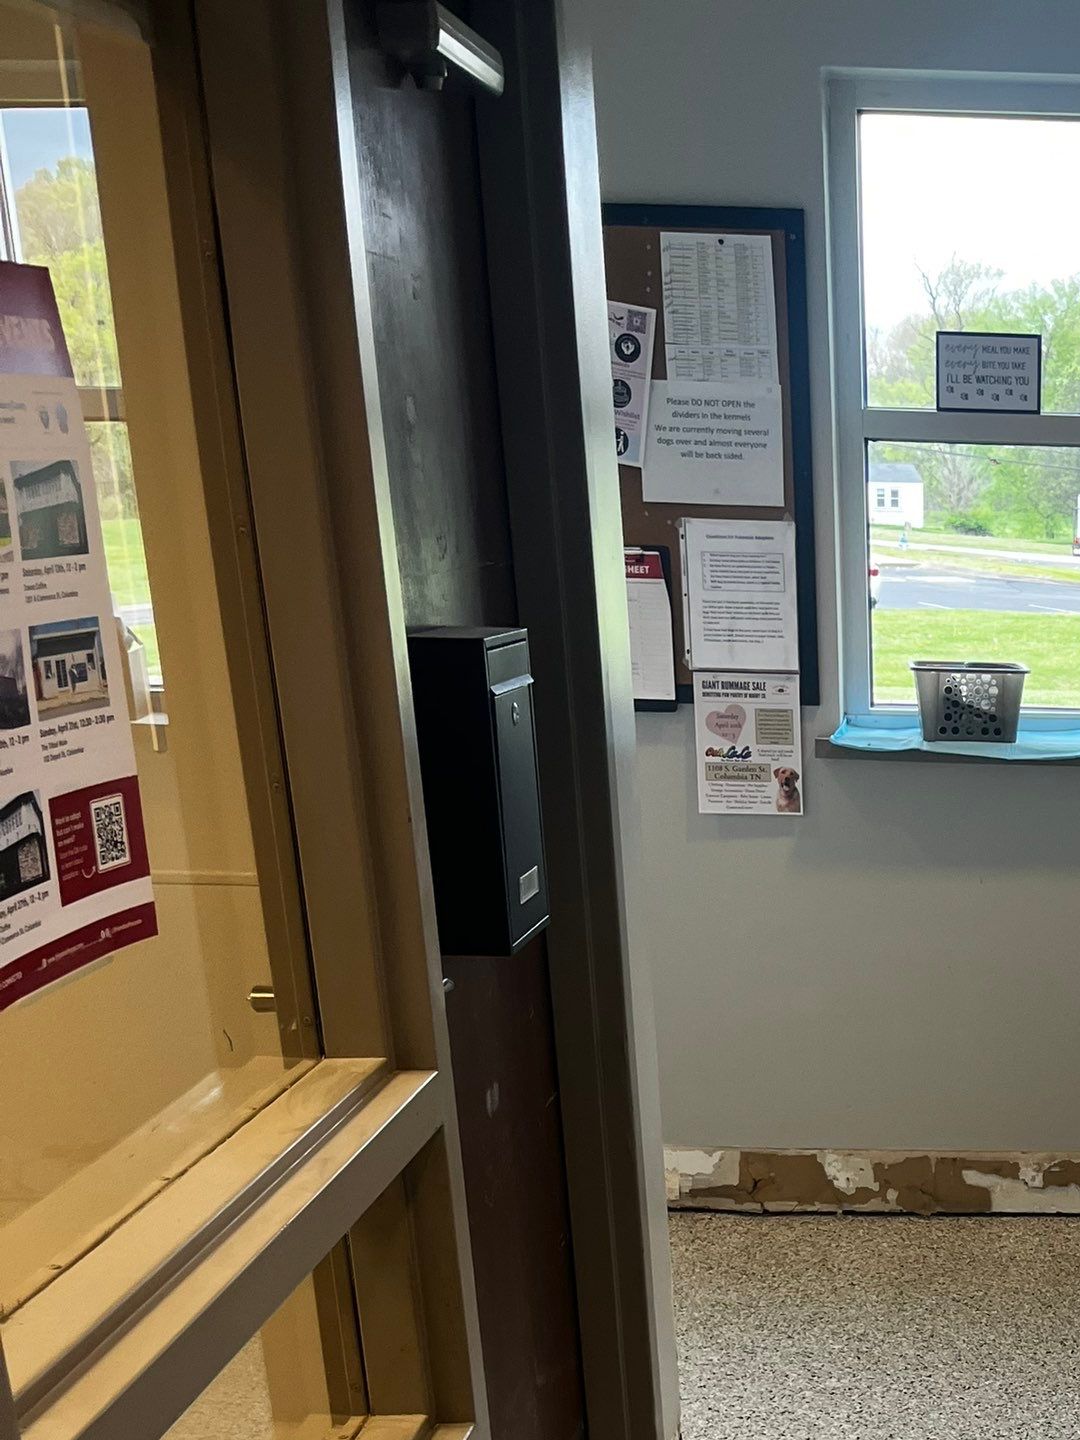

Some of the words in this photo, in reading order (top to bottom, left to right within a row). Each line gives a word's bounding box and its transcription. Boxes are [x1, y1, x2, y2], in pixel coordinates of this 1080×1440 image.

[944, 343, 980, 359] every
[982, 345, 999, 354] MEAL
[999, 346, 1012, 355] YOU
[1013, 346, 1030, 355] MAKE
[944, 359, 980, 375] every
[981, 361, 996, 369] BITE
[997, 361, 1010, 370] YOU
[1011, 362, 1026, 370] TAKE
[946, 373, 960, 384] I'LL
[962, 374, 972, 384] BE
[974, 375, 1012, 385] WATCHING
[1015, 376, 1030, 386] YOU
[666, 397, 690, 406] Please
[691, 398, 703, 407] DO
[704, 399, 720, 407] NOT
[721, 399, 741, 408] OPEN
[672, 411, 700, 419] dividers
[710, 412, 722, 420] the
[654, 424, 667, 432] We
[682, 425, 715, 435] currently
[716, 428, 742, 436] moving
[656, 437, 674, 446] dogs
[709, 439, 733, 447] almost
[734, 441, 768, 449] everyone
[680, 450, 694, 458] will
[706, 451, 722, 459] back
[702, 680, 720, 690] GIANT
[720, 681, 750, 691] RUMMAGE
[752, 682, 767, 691] SALE
[731, 765, 758, 773] Garden
